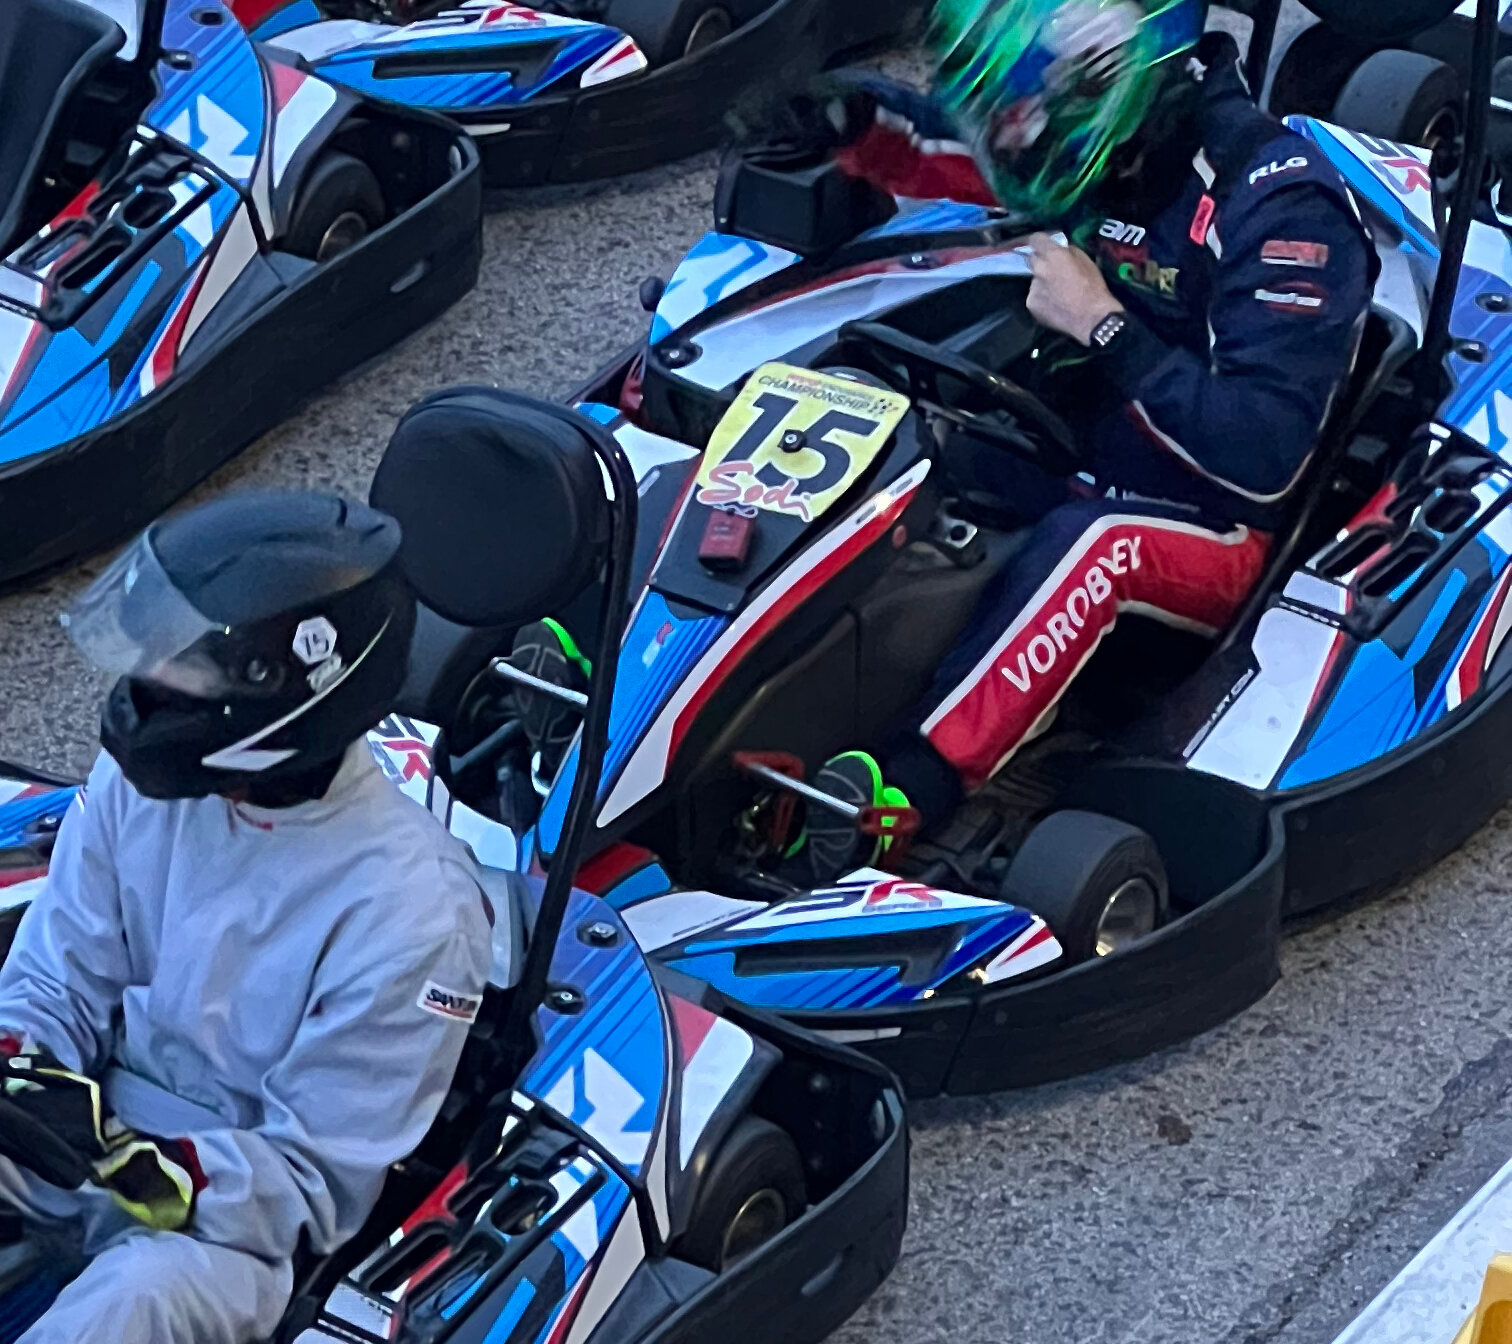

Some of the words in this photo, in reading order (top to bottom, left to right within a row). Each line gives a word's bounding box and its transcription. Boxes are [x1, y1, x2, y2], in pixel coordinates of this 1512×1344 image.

[758, 374, 870, 413] CHAMPIONSHIP
[717, 392, 881, 495] 15
[697, 460, 814, 522] Sodi
